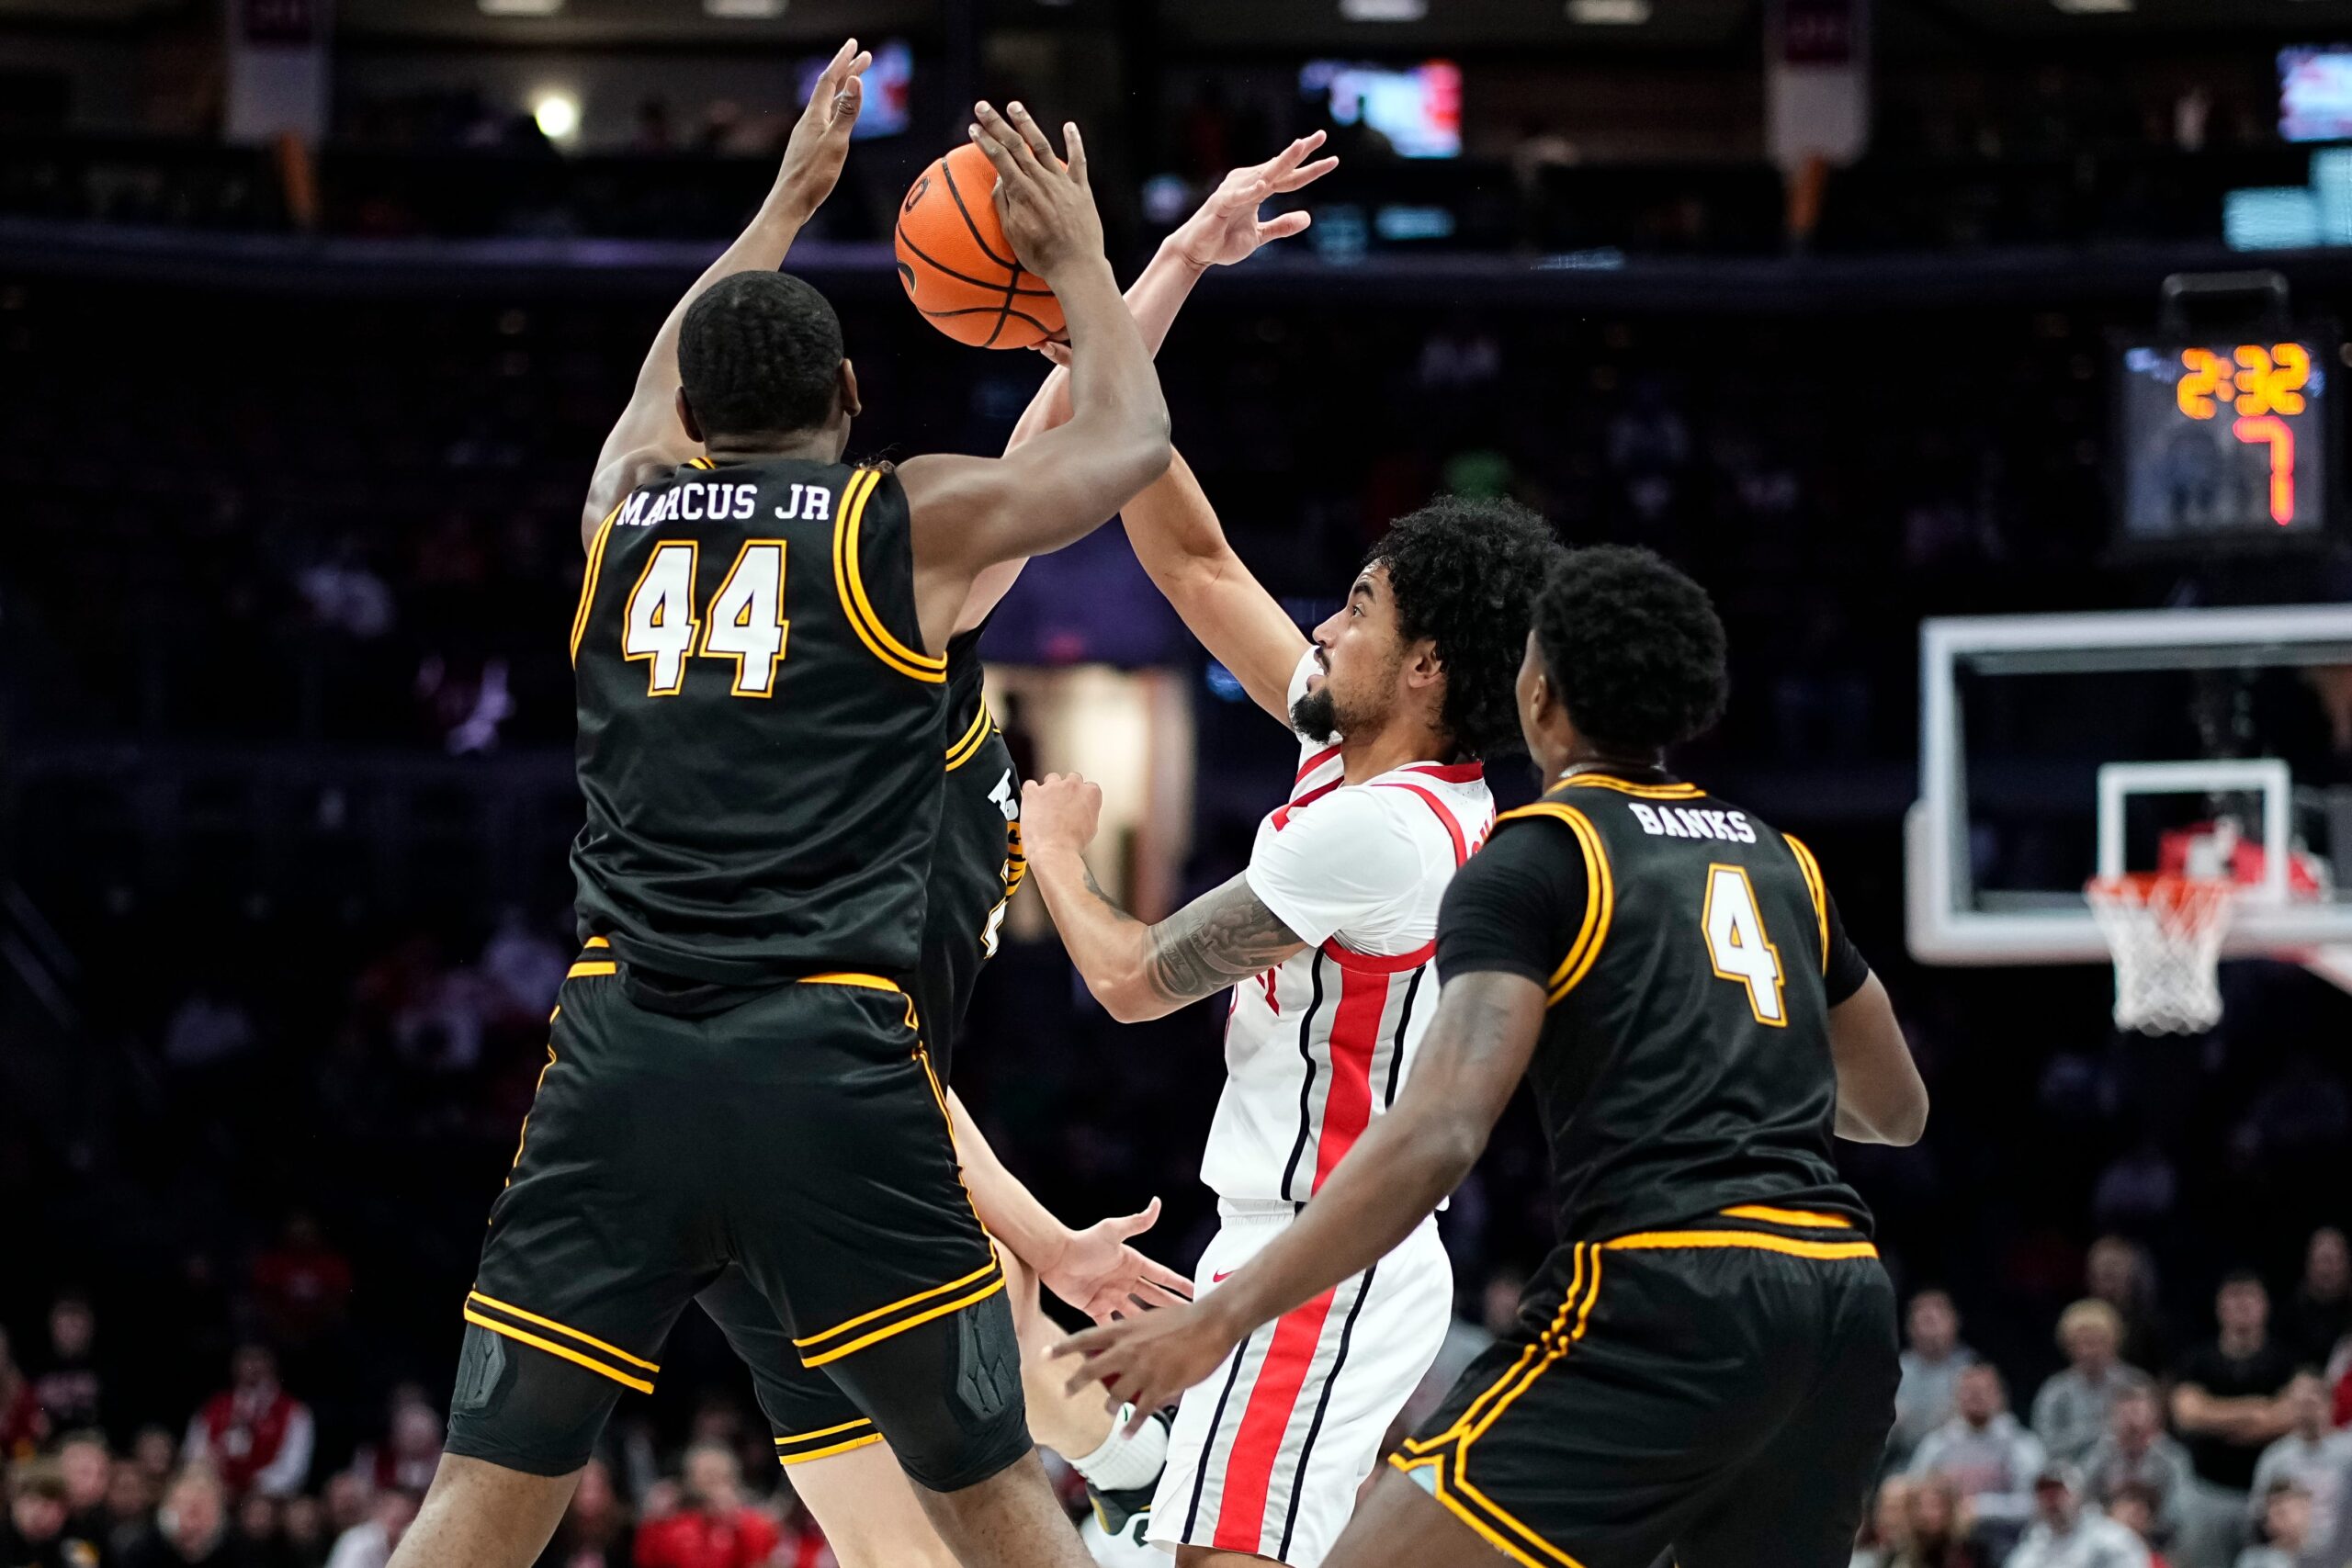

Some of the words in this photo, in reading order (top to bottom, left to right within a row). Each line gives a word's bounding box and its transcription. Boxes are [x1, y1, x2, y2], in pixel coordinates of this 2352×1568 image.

[2177, 343, 2311, 420] 2:32
[616, 482, 758, 526] MARCUS
[775, 483, 831, 521] JR
[2233, 415, 2295, 526] 7
[621, 538, 790, 698] 44
[1628, 802, 1757, 844] BANKS
[1701, 862, 1789, 1028] 4
